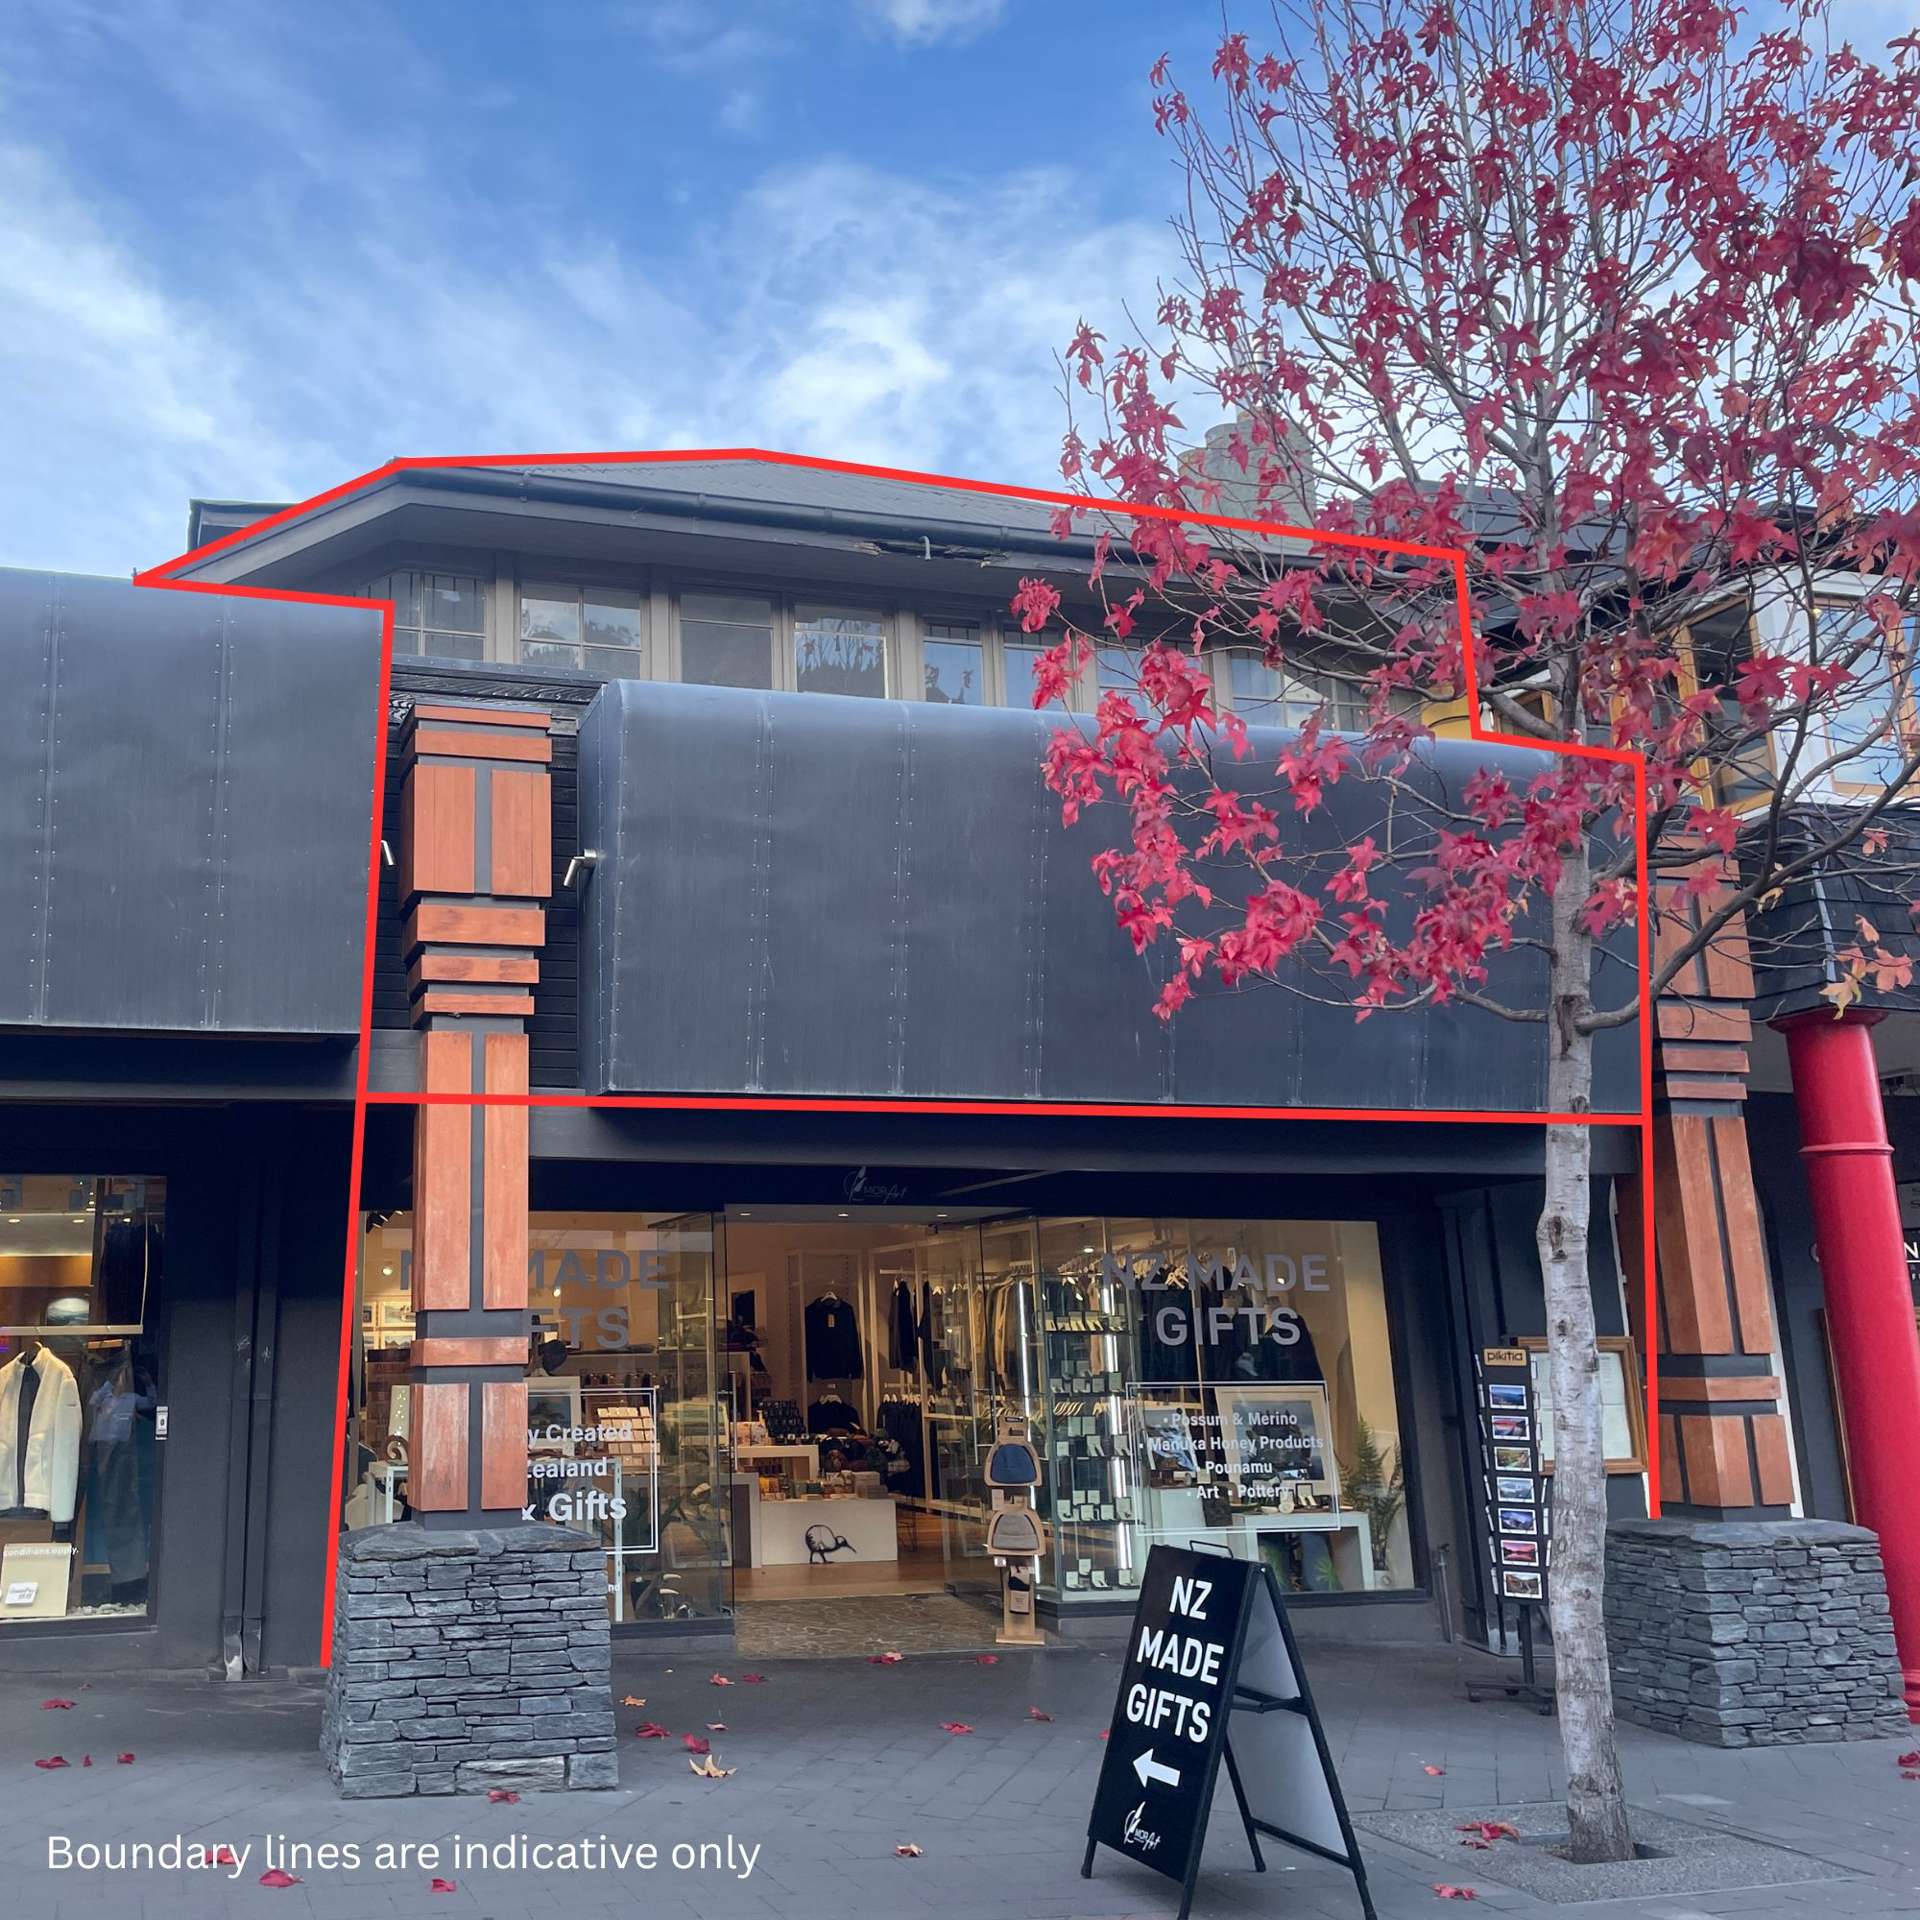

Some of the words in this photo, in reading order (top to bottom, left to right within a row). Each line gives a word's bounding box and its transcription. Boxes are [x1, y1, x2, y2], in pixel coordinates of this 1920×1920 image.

[1103, 1253, 1167, 1292] NZ
[1187, 1254, 1330, 1292] MADE
[1155, 1307, 1301, 1347] GIFTS
[546, 1423, 632, 1442] Created
[1172, 1413, 1228, 1426] Possum
[1233, 1413, 1243, 1425] &
[1248, 1413, 1298, 1426] Merino
[1210, 1437, 1257, 1453] Honey
[1260, 1435, 1324, 1450] Products
[1206, 1461, 1273, 1475] Pounamu
[549, 1490, 627, 1521] Gifts
[1197, 1485, 1220, 1499] Art
[1238, 1485, 1290, 1500] Pottery
[1169, 1575, 1213, 1620] NZ
[1136, 1625, 1224, 1685] MADE
[1126, 1683, 1211, 1743] GIFTS
